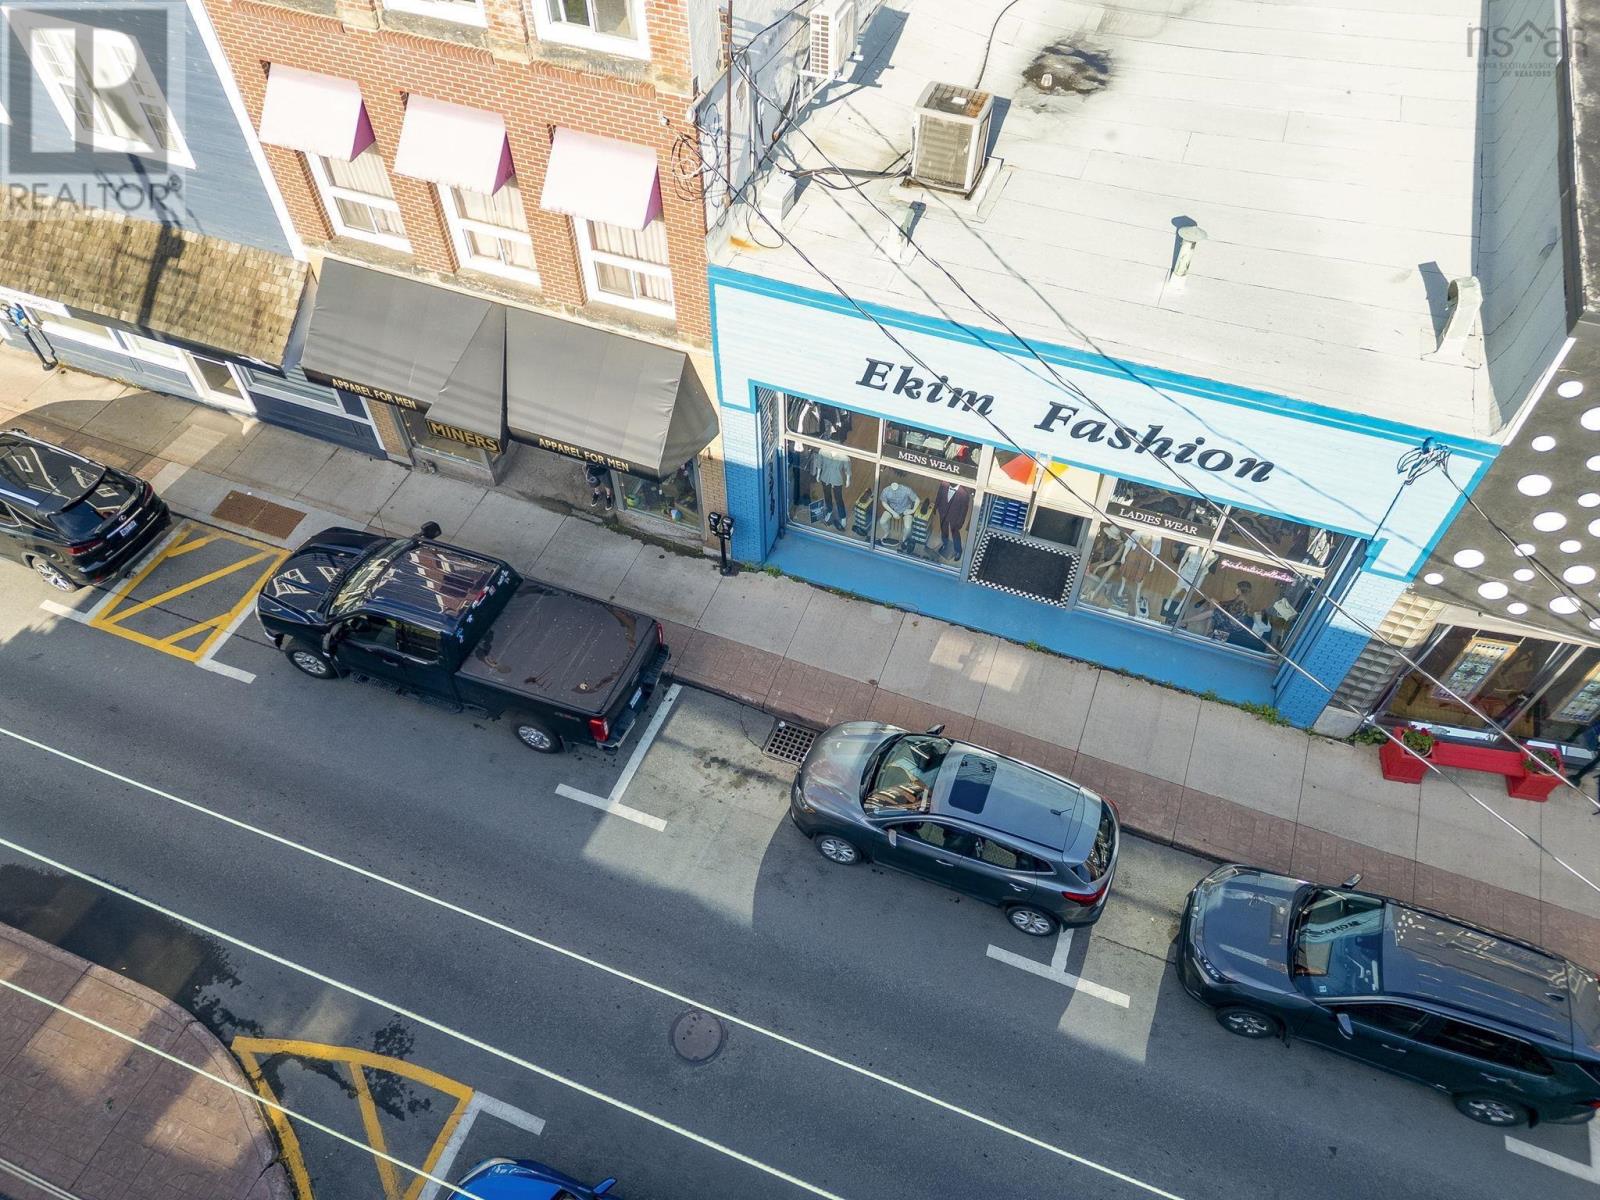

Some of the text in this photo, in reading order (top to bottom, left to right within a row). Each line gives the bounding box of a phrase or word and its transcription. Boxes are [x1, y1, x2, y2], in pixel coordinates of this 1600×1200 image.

[332, 378, 417, 410] APPAREL FOR MEN
[855, 357, 1275, 483] Ekim Fashion
[431, 423, 498, 451] MINERS
[538, 438, 630, 473] APPAREL FOR MEN
[898, 451, 960, 474] MENS WEAR
[1119, 508, 1198, 535] LADIES WEAR
